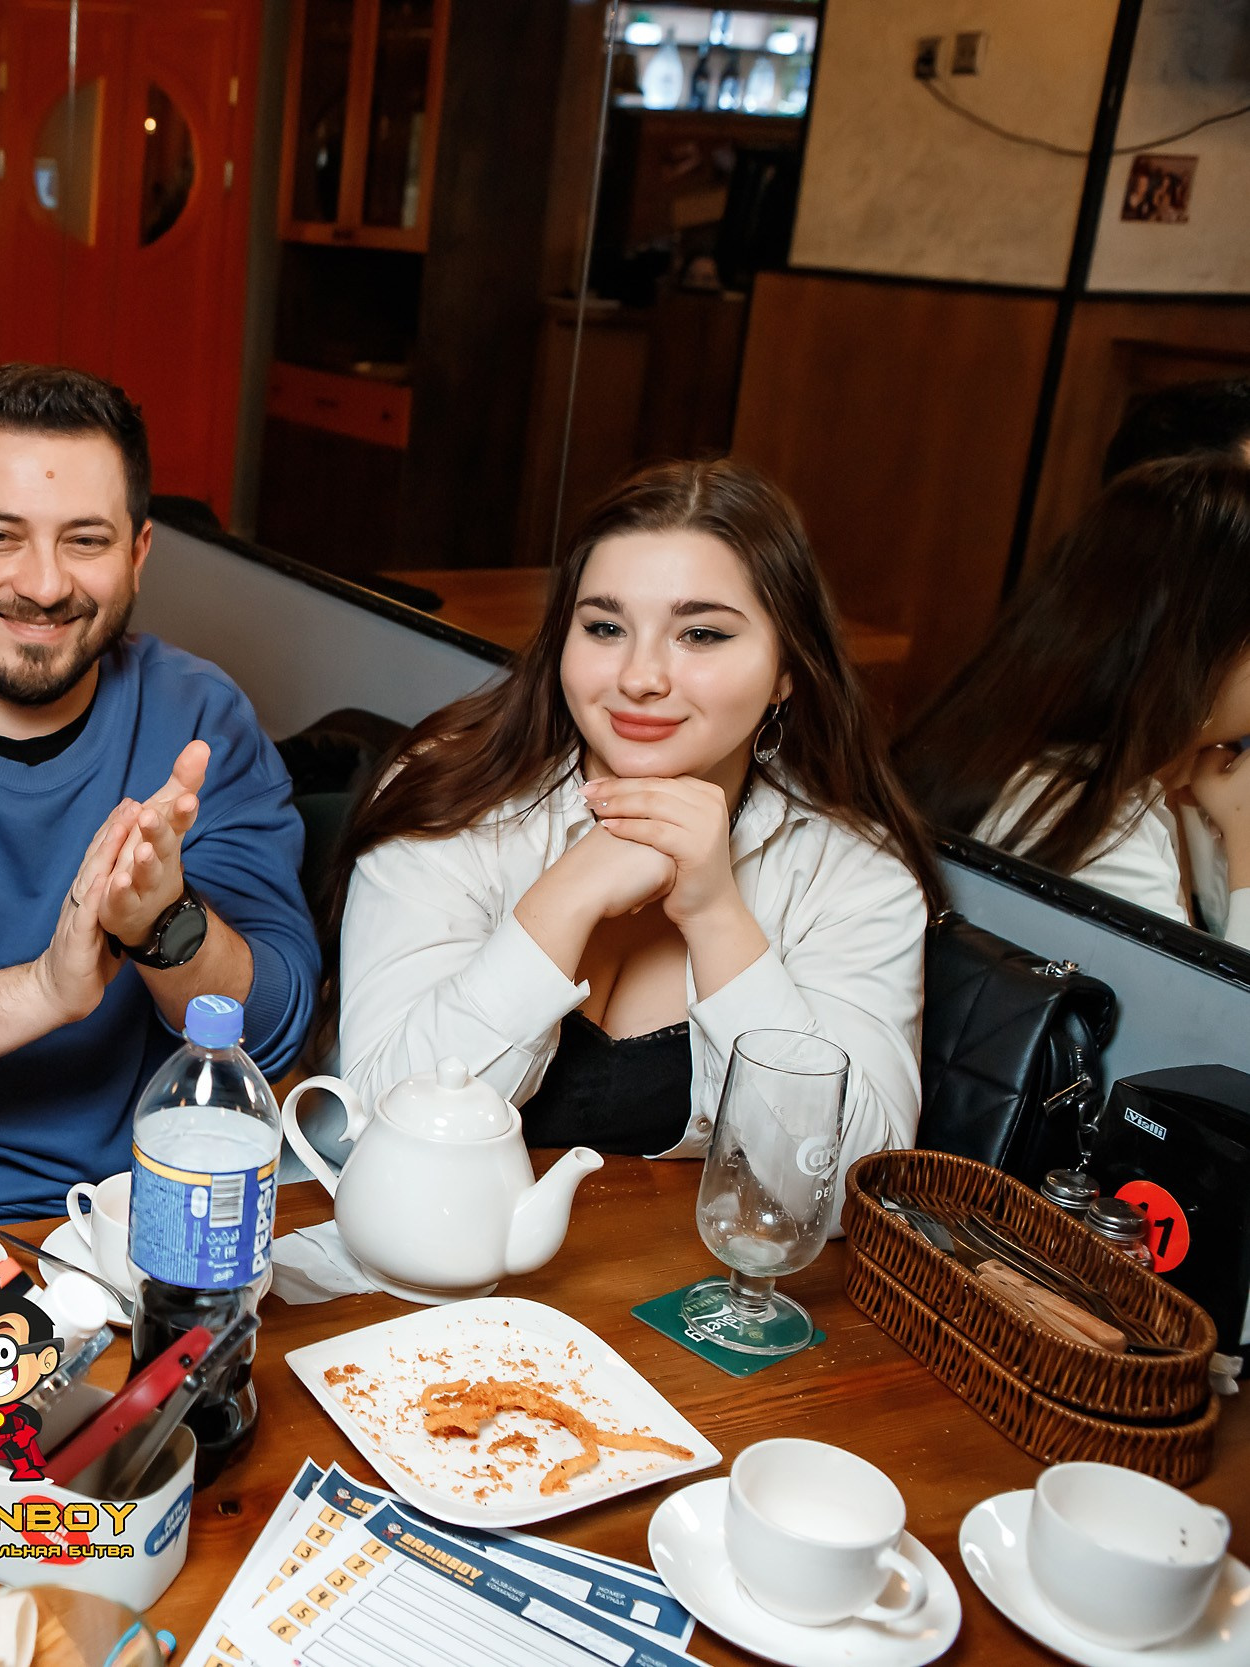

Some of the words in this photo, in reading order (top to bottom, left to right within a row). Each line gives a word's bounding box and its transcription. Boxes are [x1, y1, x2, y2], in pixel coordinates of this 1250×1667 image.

[1127, 1110, 1164, 1138] Vialli
[252, 1177, 274, 1275] PEPSI
[400, 1532, 484, 1580] BRAINBOY
[333, 1575, 347, 1587] 3
[296, 1607, 310, 1619] 5
